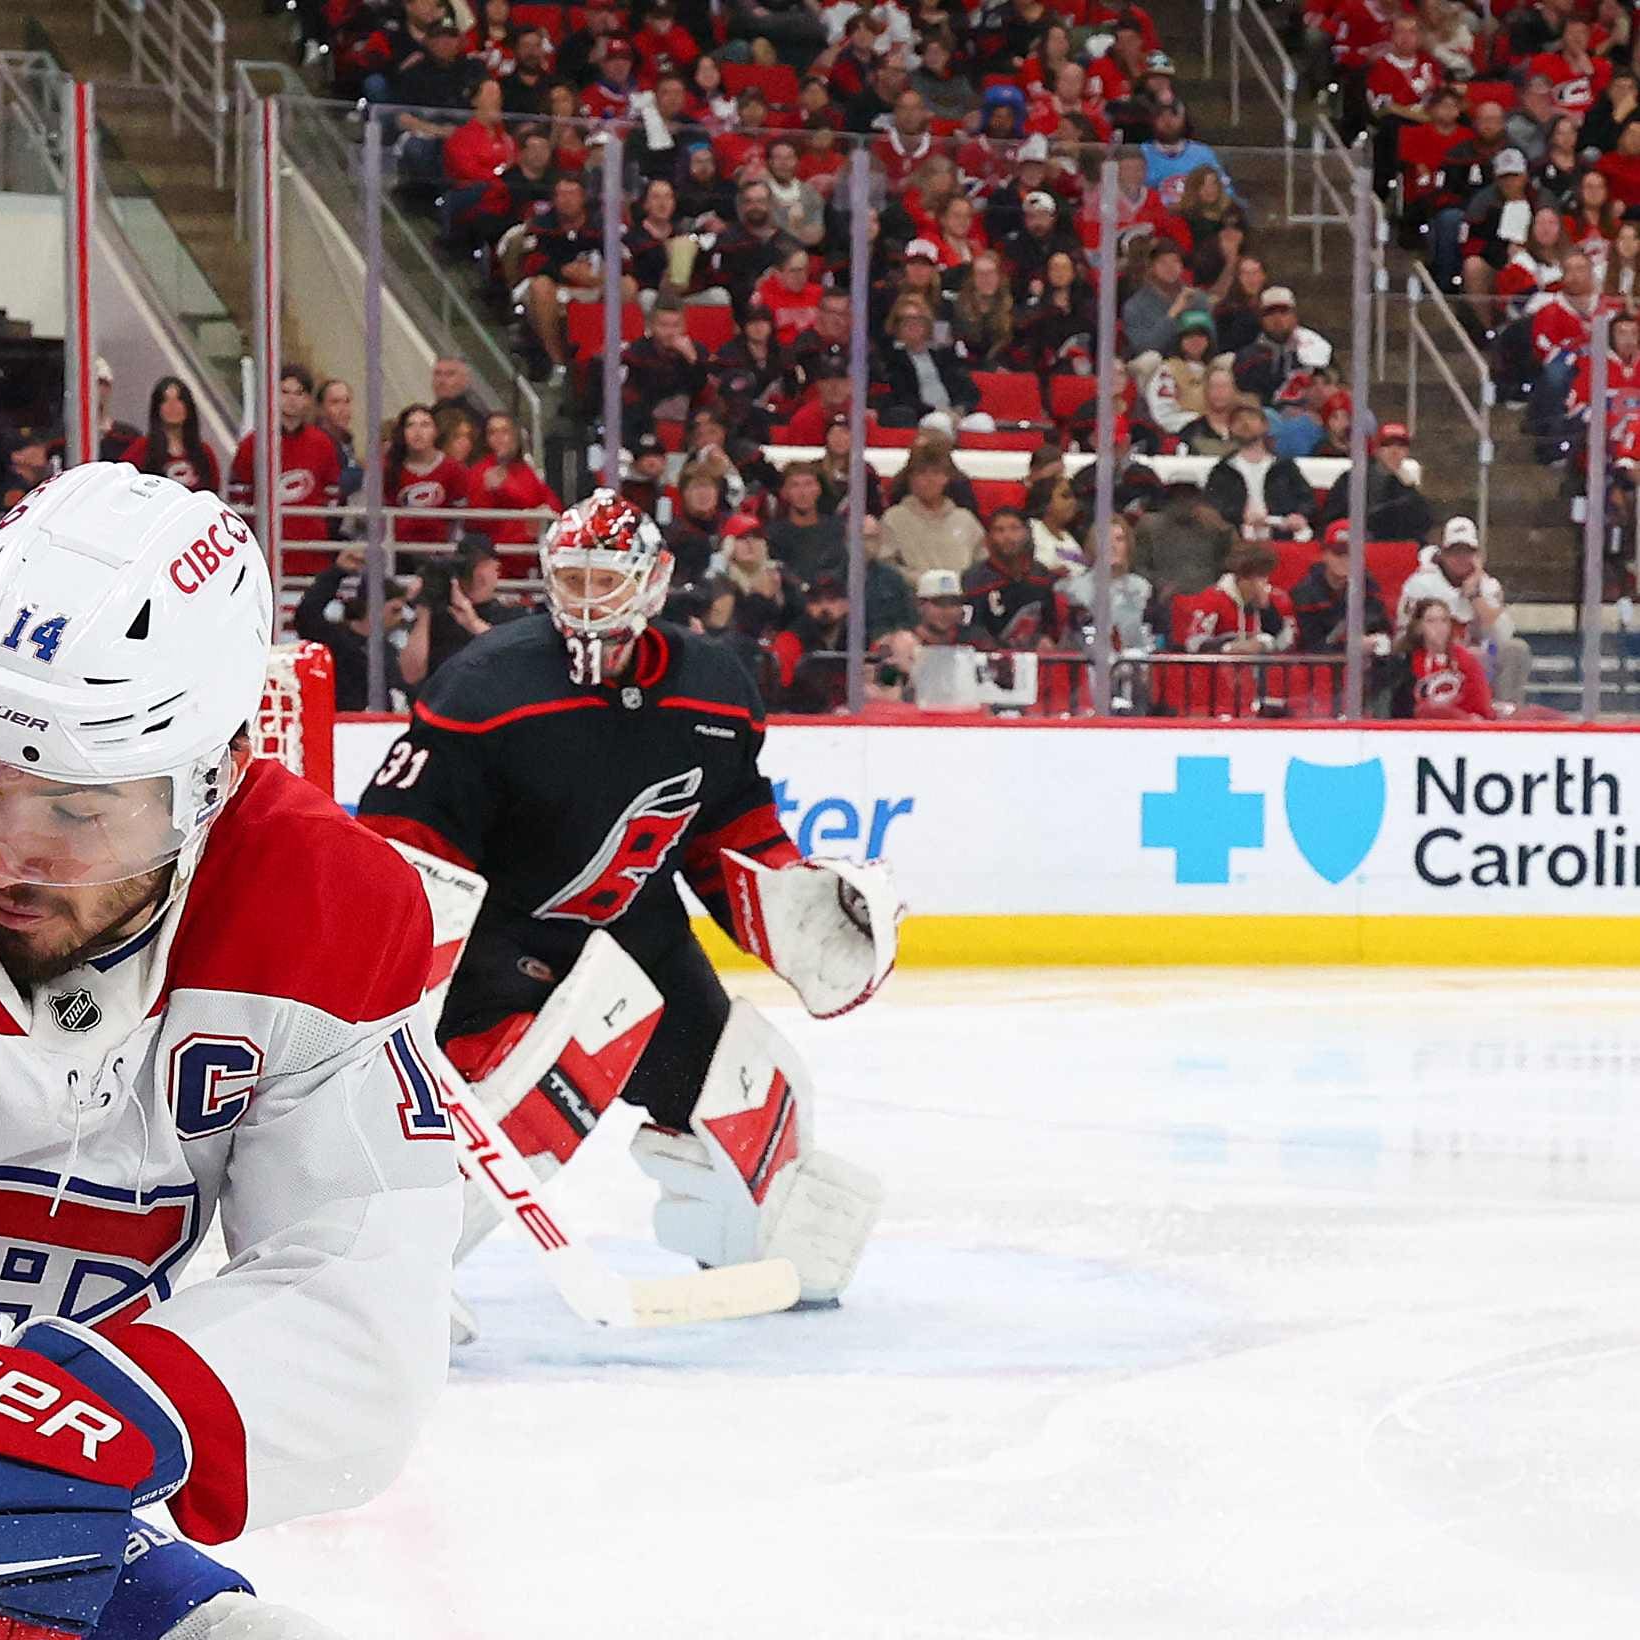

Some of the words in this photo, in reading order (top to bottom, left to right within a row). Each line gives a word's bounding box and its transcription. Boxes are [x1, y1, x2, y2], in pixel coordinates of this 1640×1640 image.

[169, 523, 235, 594] CIBC
[0, 603, 71, 665] 14
[566, 636, 603, 686] 31
[375, 740, 432, 790] 31
[1416, 756, 1620, 816] North
[772, 778, 915, 860] ter
[1414, 825, 1640, 887] Caroli
[168, 1033, 264, 1143] C
[440, 1074, 570, 1252] RUE
